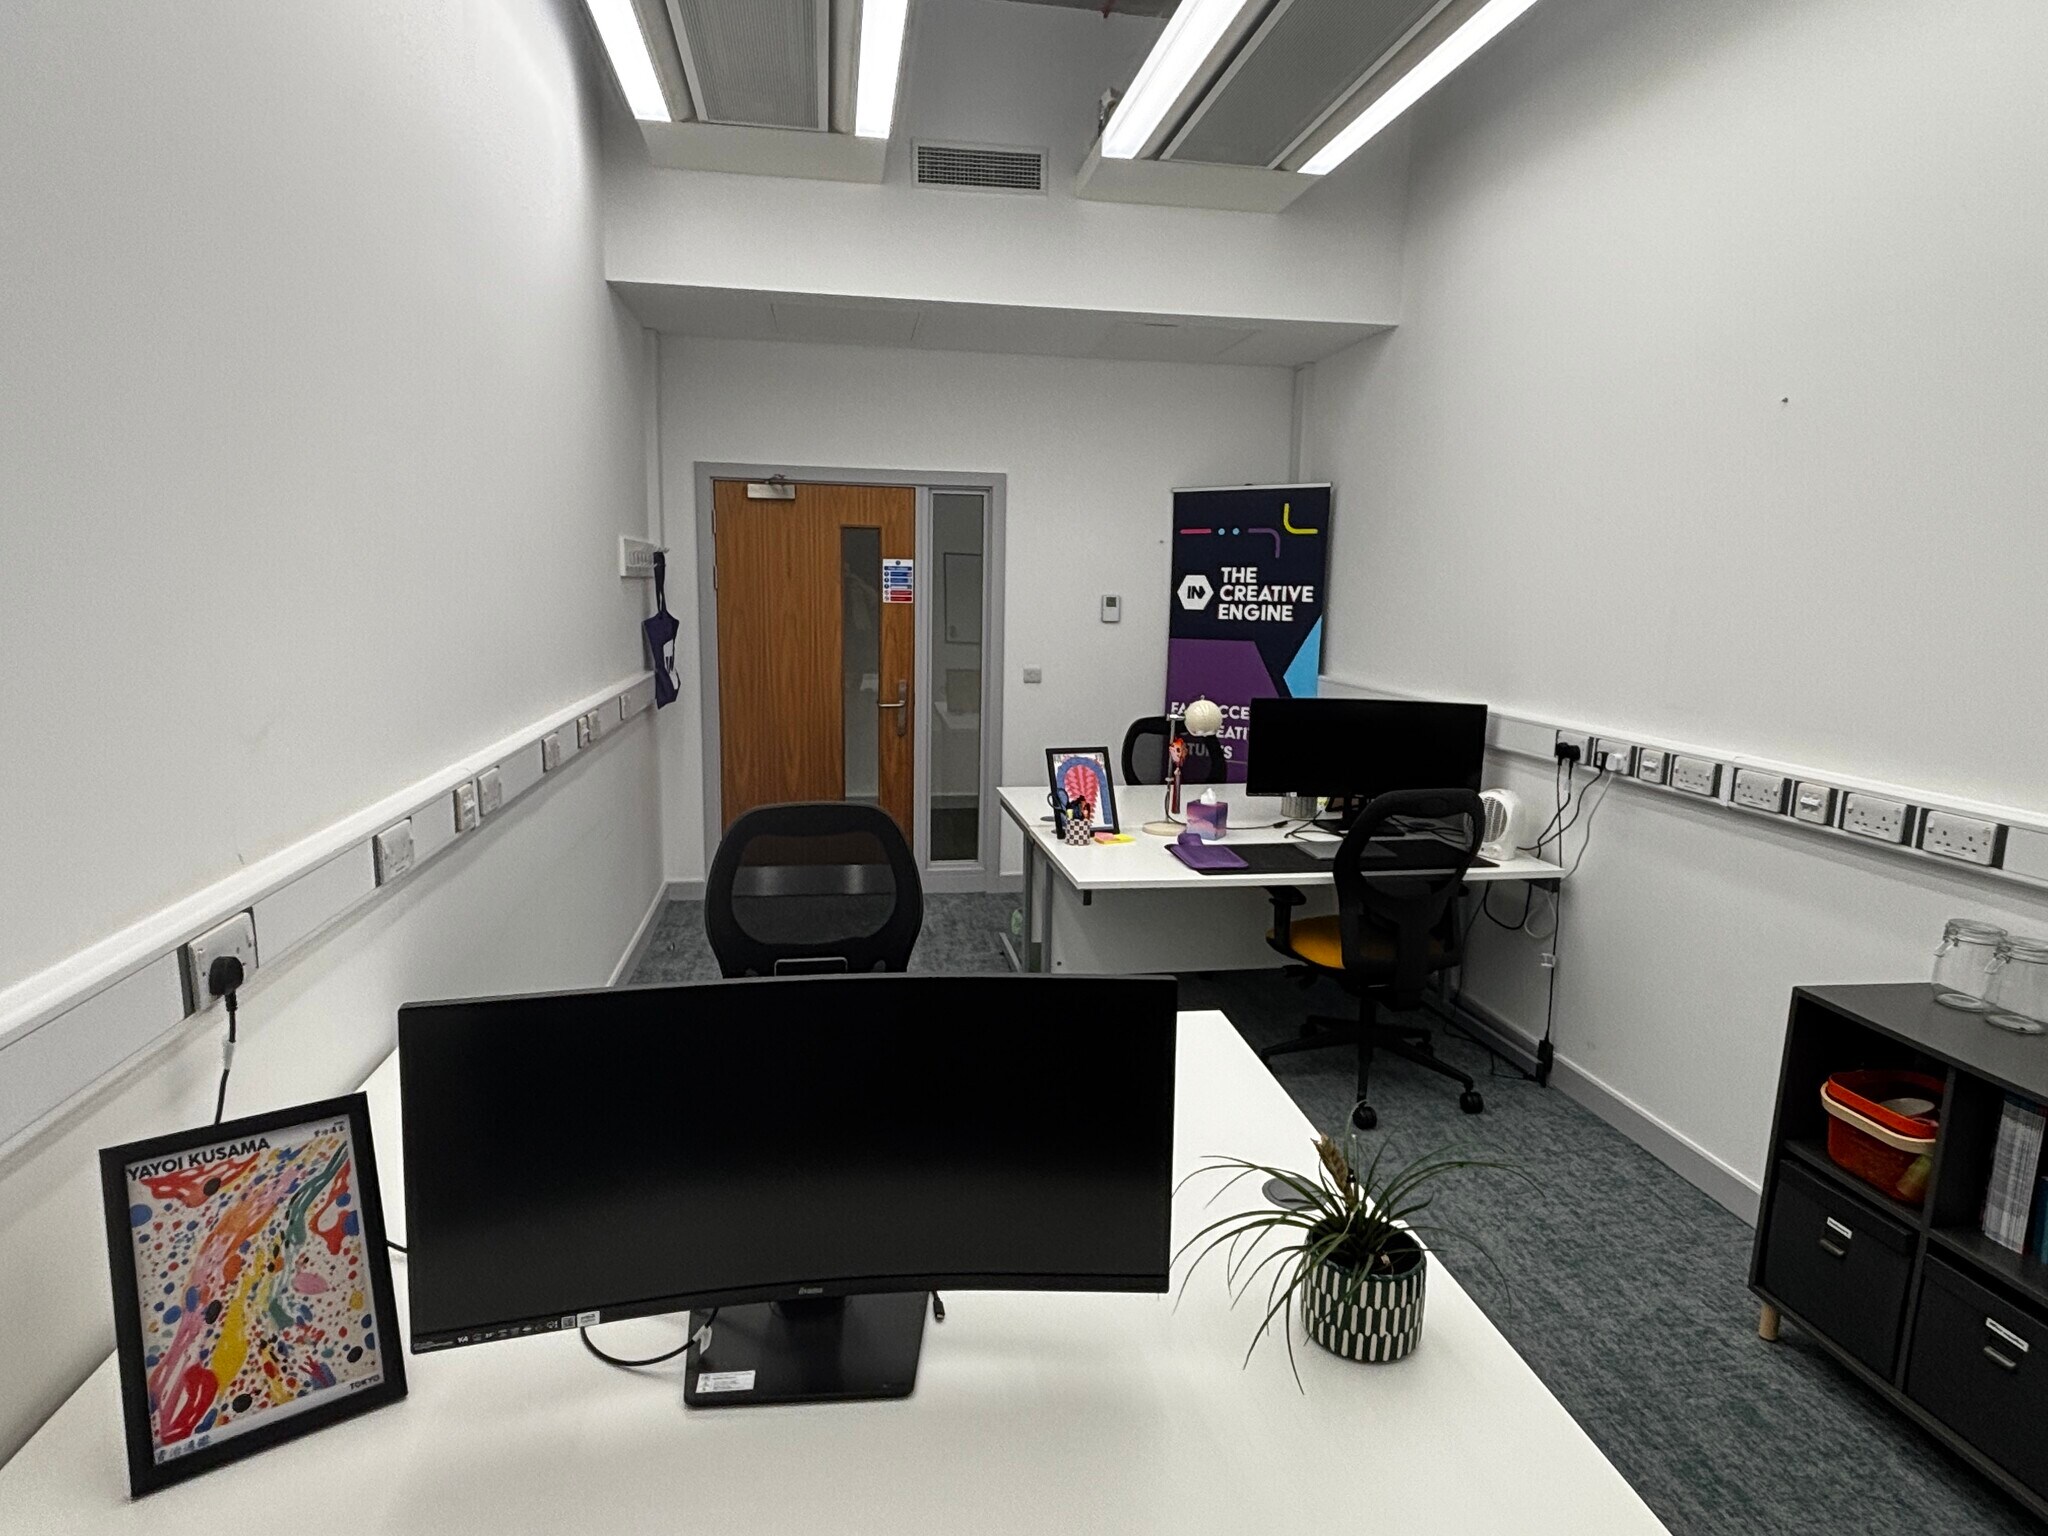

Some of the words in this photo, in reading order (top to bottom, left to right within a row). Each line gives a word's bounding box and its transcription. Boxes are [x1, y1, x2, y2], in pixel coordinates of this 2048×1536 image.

[1221, 567, 1258, 583] THE
[1219, 585, 1314, 603] CREATIVE
[1217, 604, 1294, 622] ENGINE
[126, 1158, 184, 1181] YAYOI
[188, 1137, 271, 1169] KUSAMA
